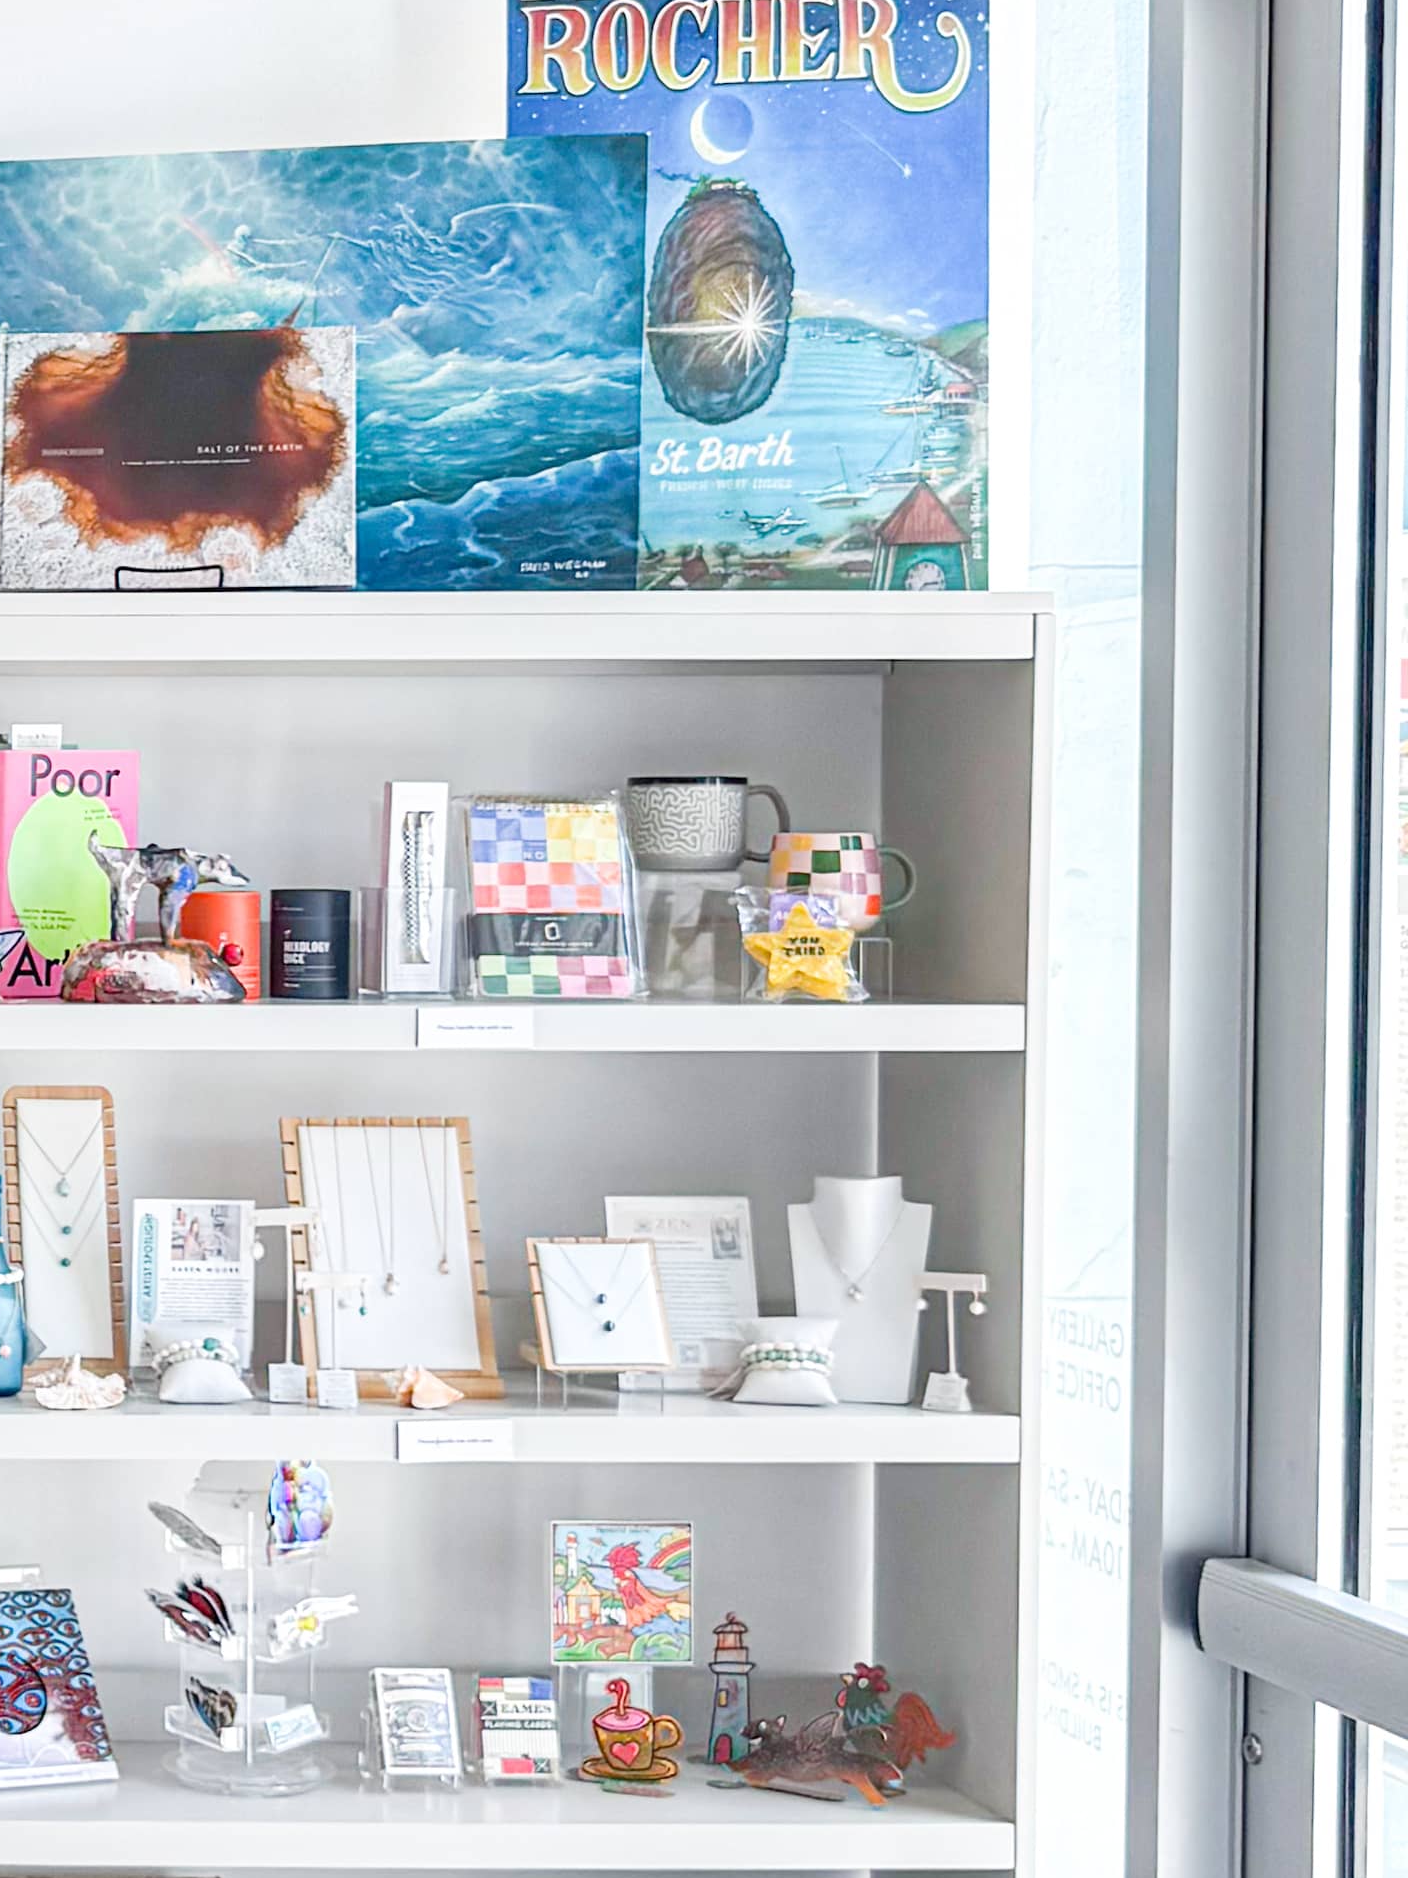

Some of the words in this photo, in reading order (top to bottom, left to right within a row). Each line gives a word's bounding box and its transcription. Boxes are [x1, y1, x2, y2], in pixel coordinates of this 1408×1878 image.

[226, 444, 239, 453] OF
[245, 444, 263, 453] THE
[268, 443, 303, 452] EARTH
[649, 438, 689, 475] St.
[696, 429, 796, 472] Barth
[31, 754, 120, 797] Poor
[501, 1703, 552, 1714] EAMES
